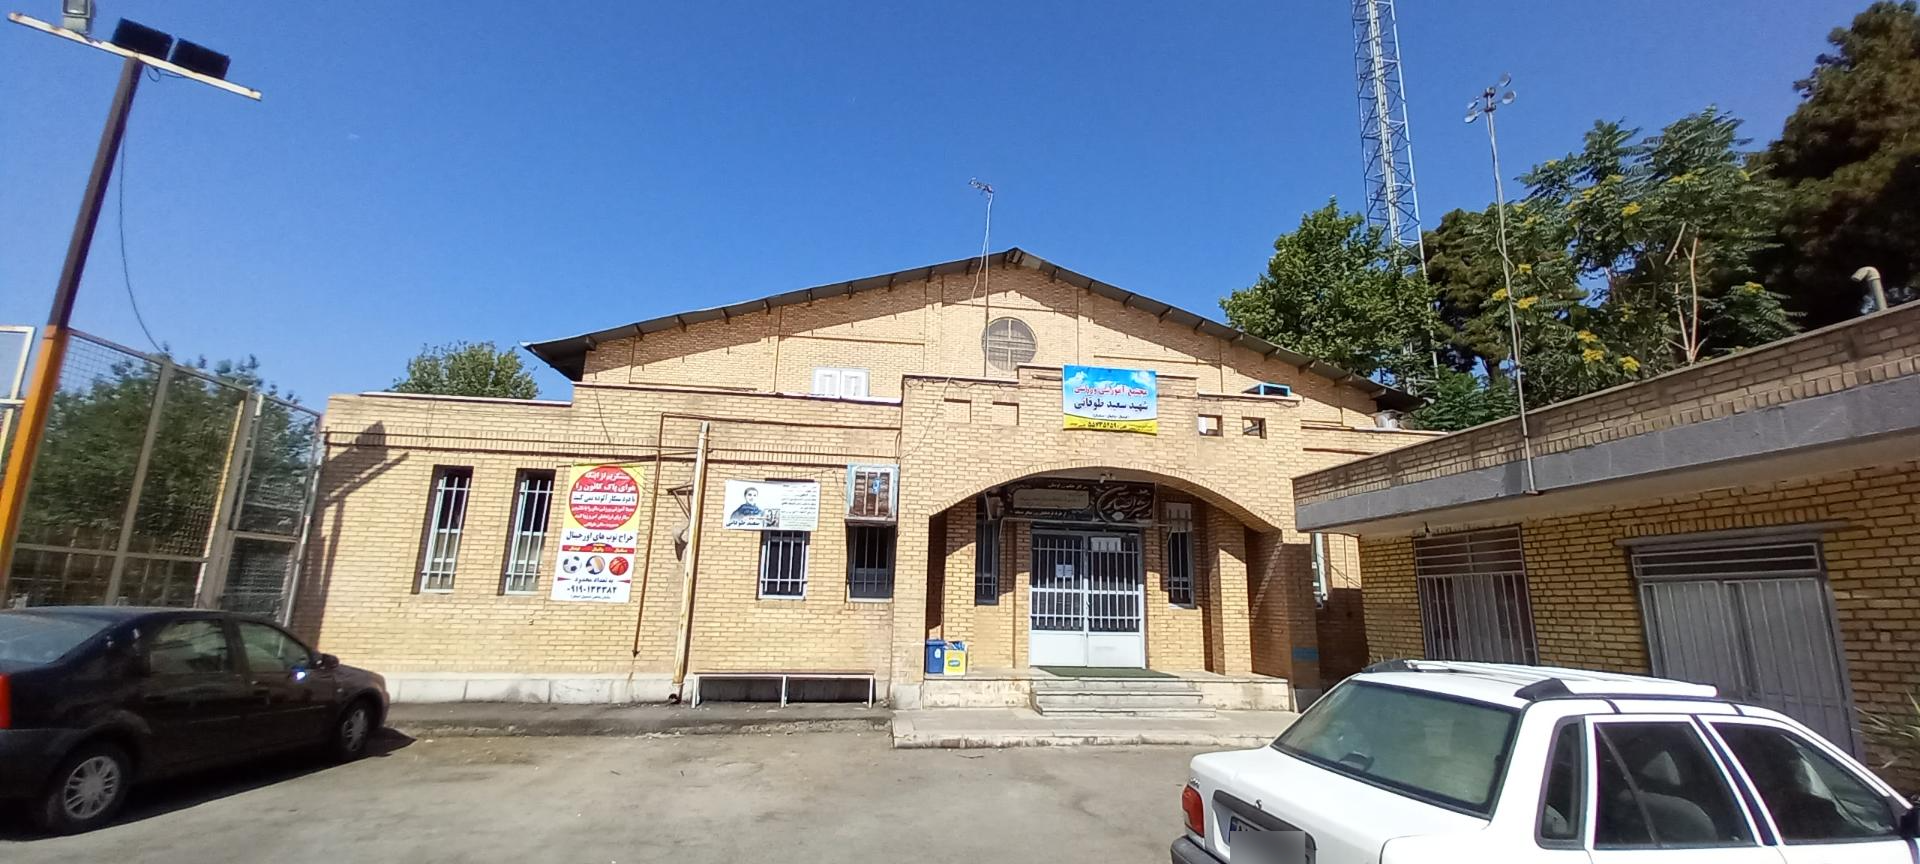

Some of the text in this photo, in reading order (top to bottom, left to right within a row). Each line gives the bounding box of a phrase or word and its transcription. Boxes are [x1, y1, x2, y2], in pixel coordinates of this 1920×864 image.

[1074, 385, 1147, 396] مجتمع آموزشی ورزشی
[1074, 396, 1148, 412] شهید سعید طوفانی
[575, 481, 637, 493] هوای پاک کانون را
[594, 494, 608, 503] آلوده
[566, 531, 633, 543] حراج توپ های اورجینال
